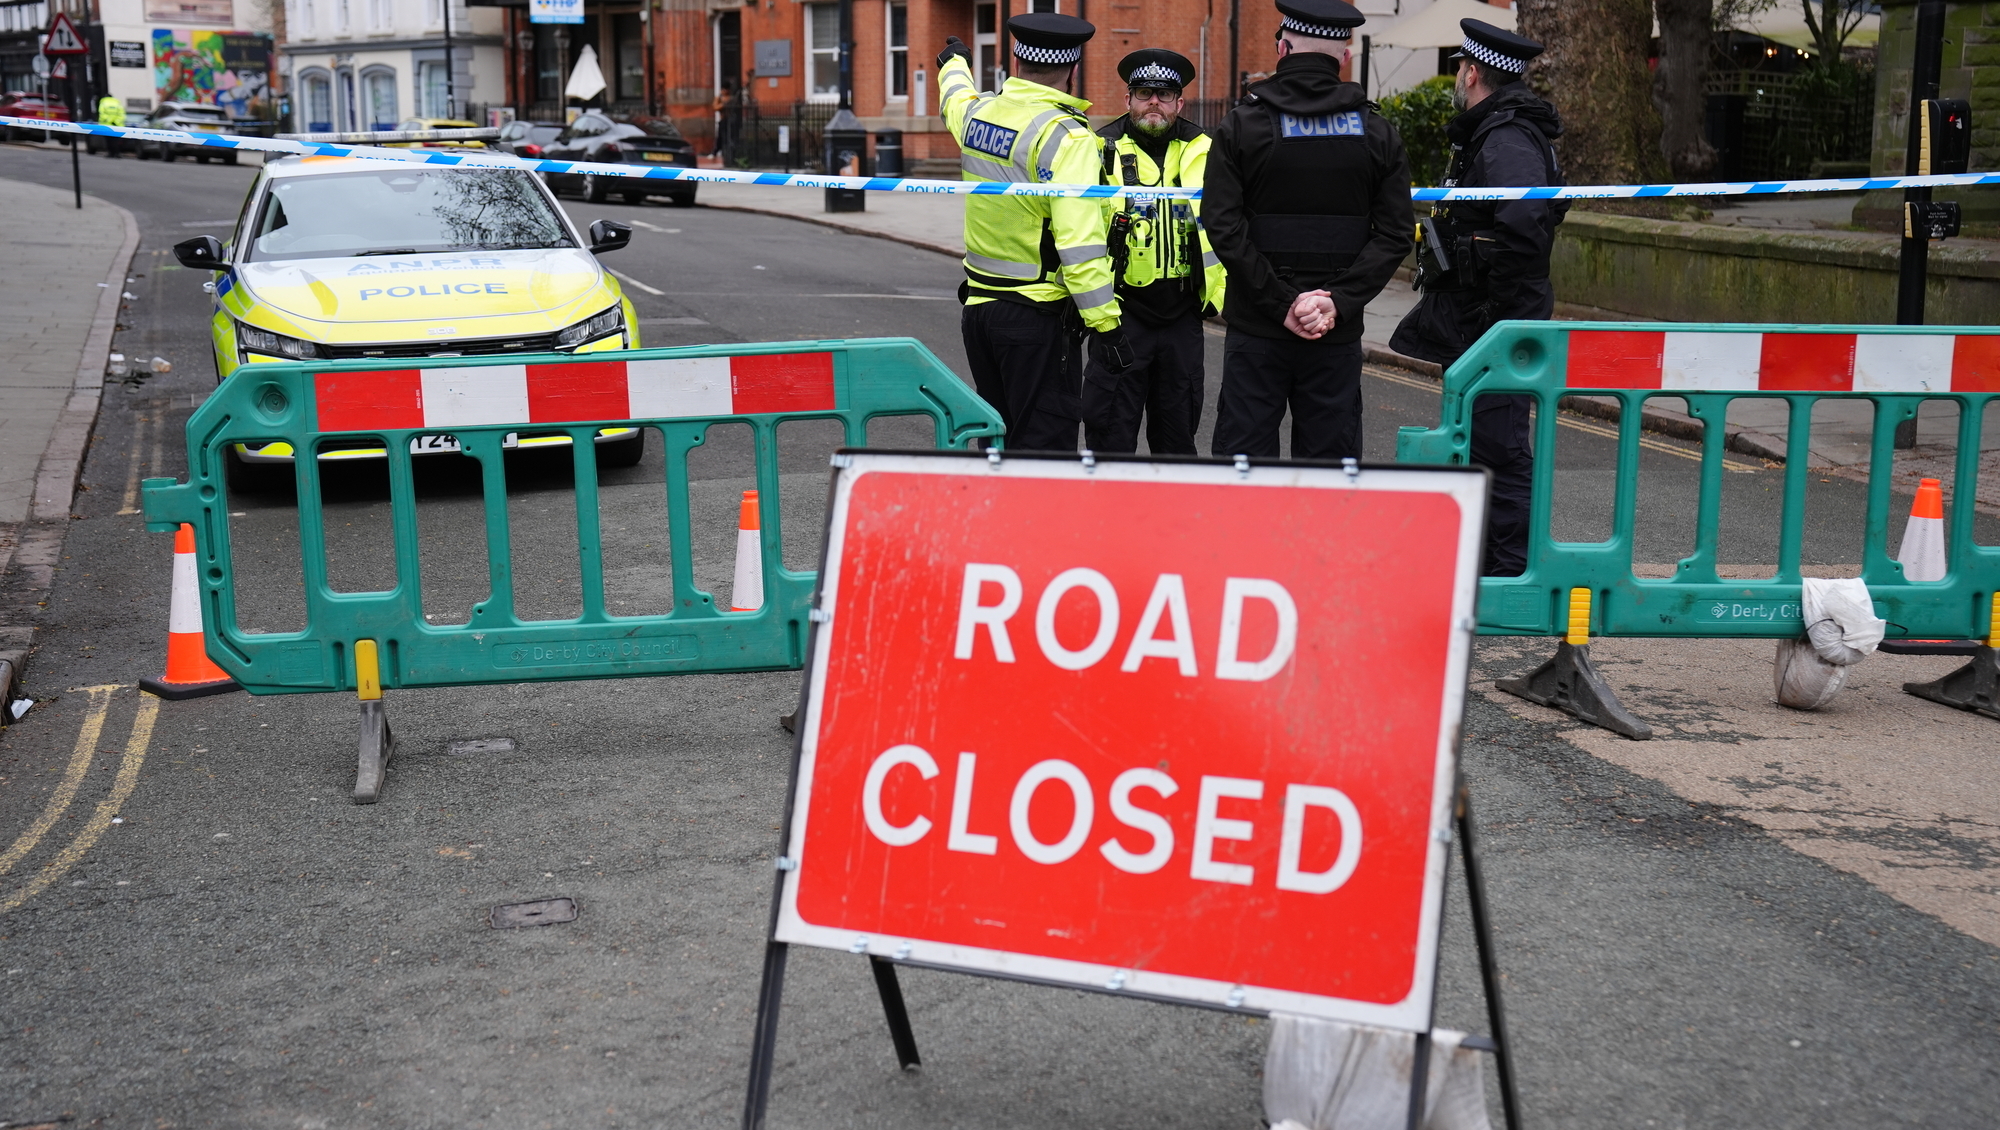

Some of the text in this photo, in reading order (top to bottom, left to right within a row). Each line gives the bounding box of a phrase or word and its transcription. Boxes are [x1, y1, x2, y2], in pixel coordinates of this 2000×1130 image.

[1283, 112, 1362, 136] POLICE
[965, 121, 1014, 156] POLICE
[348, 258, 503, 272] ANPR
[359, 283, 508, 301] POLICE
[953, 562, 1299, 682] ROAD
[1731, 603, 1804, 621] Derby Cit
[533, 639, 682, 662] Derby City Council
[862, 744, 1363, 894] CLOSED
